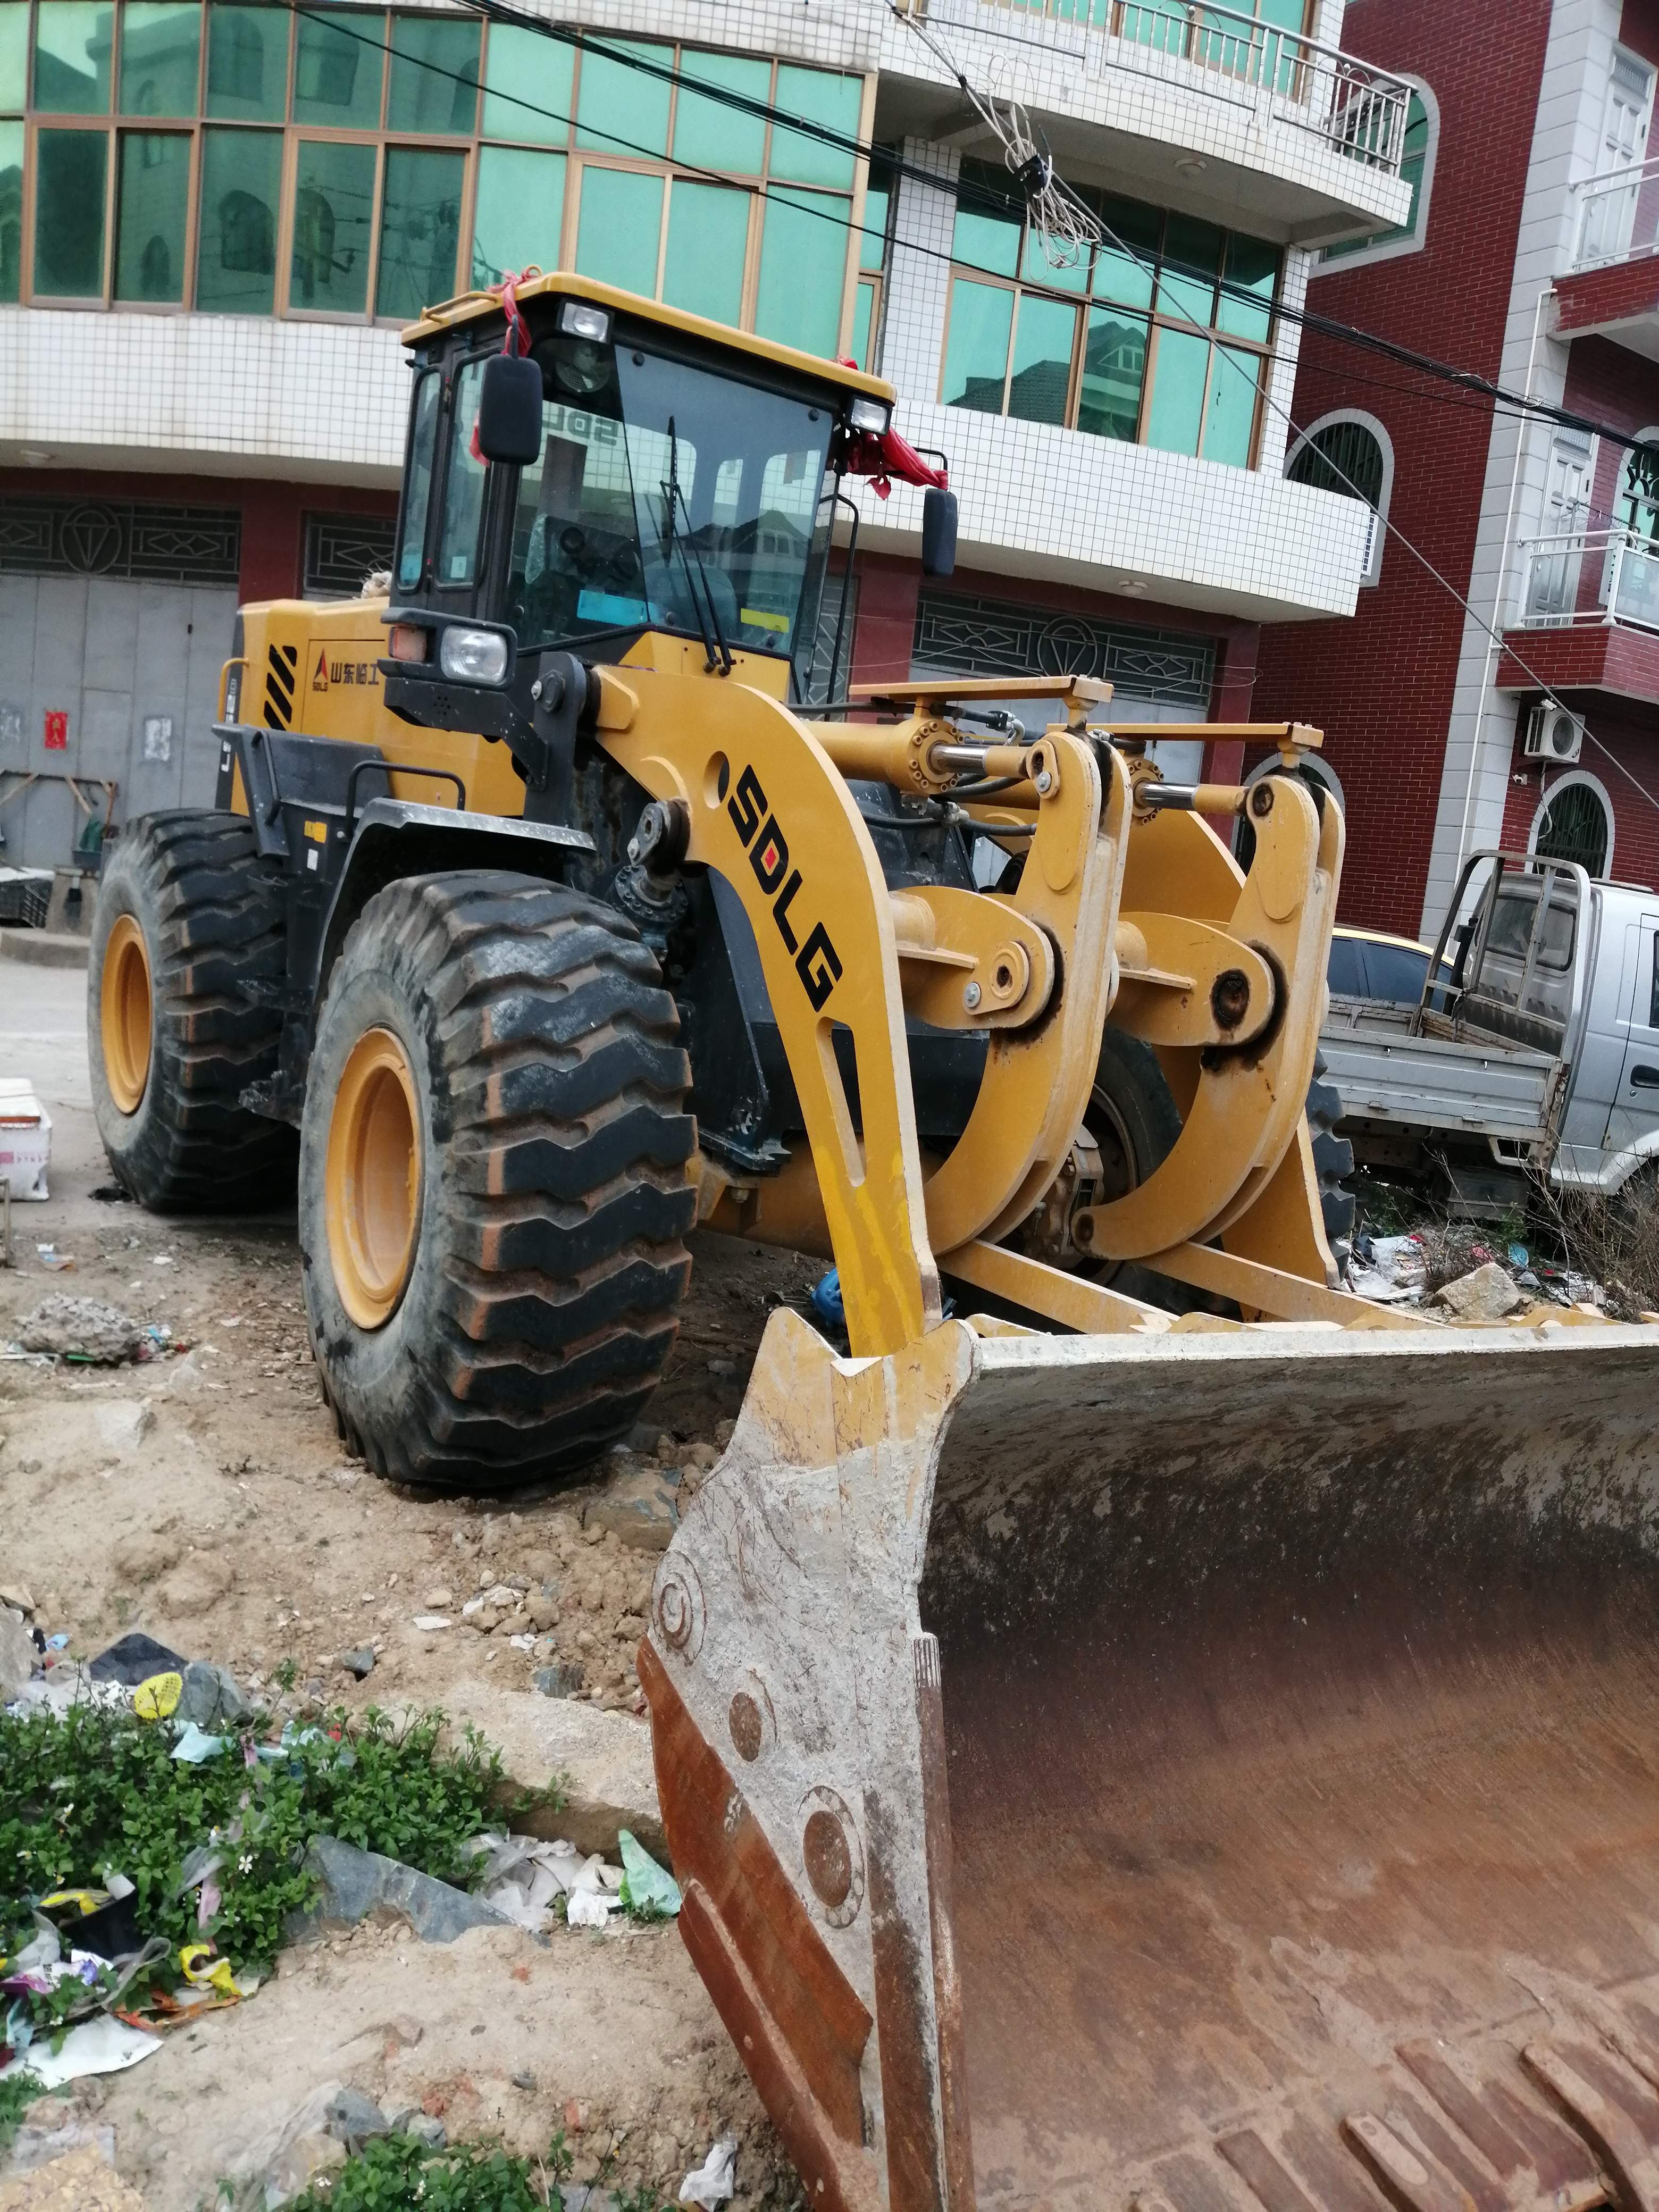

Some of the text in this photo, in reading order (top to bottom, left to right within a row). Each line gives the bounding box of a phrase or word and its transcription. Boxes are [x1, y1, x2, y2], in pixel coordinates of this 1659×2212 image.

[331, 663, 379, 685] 山东临工
[312, 681, 328, 692] SDLG
[727, 764, 843, 1013] SDLG
